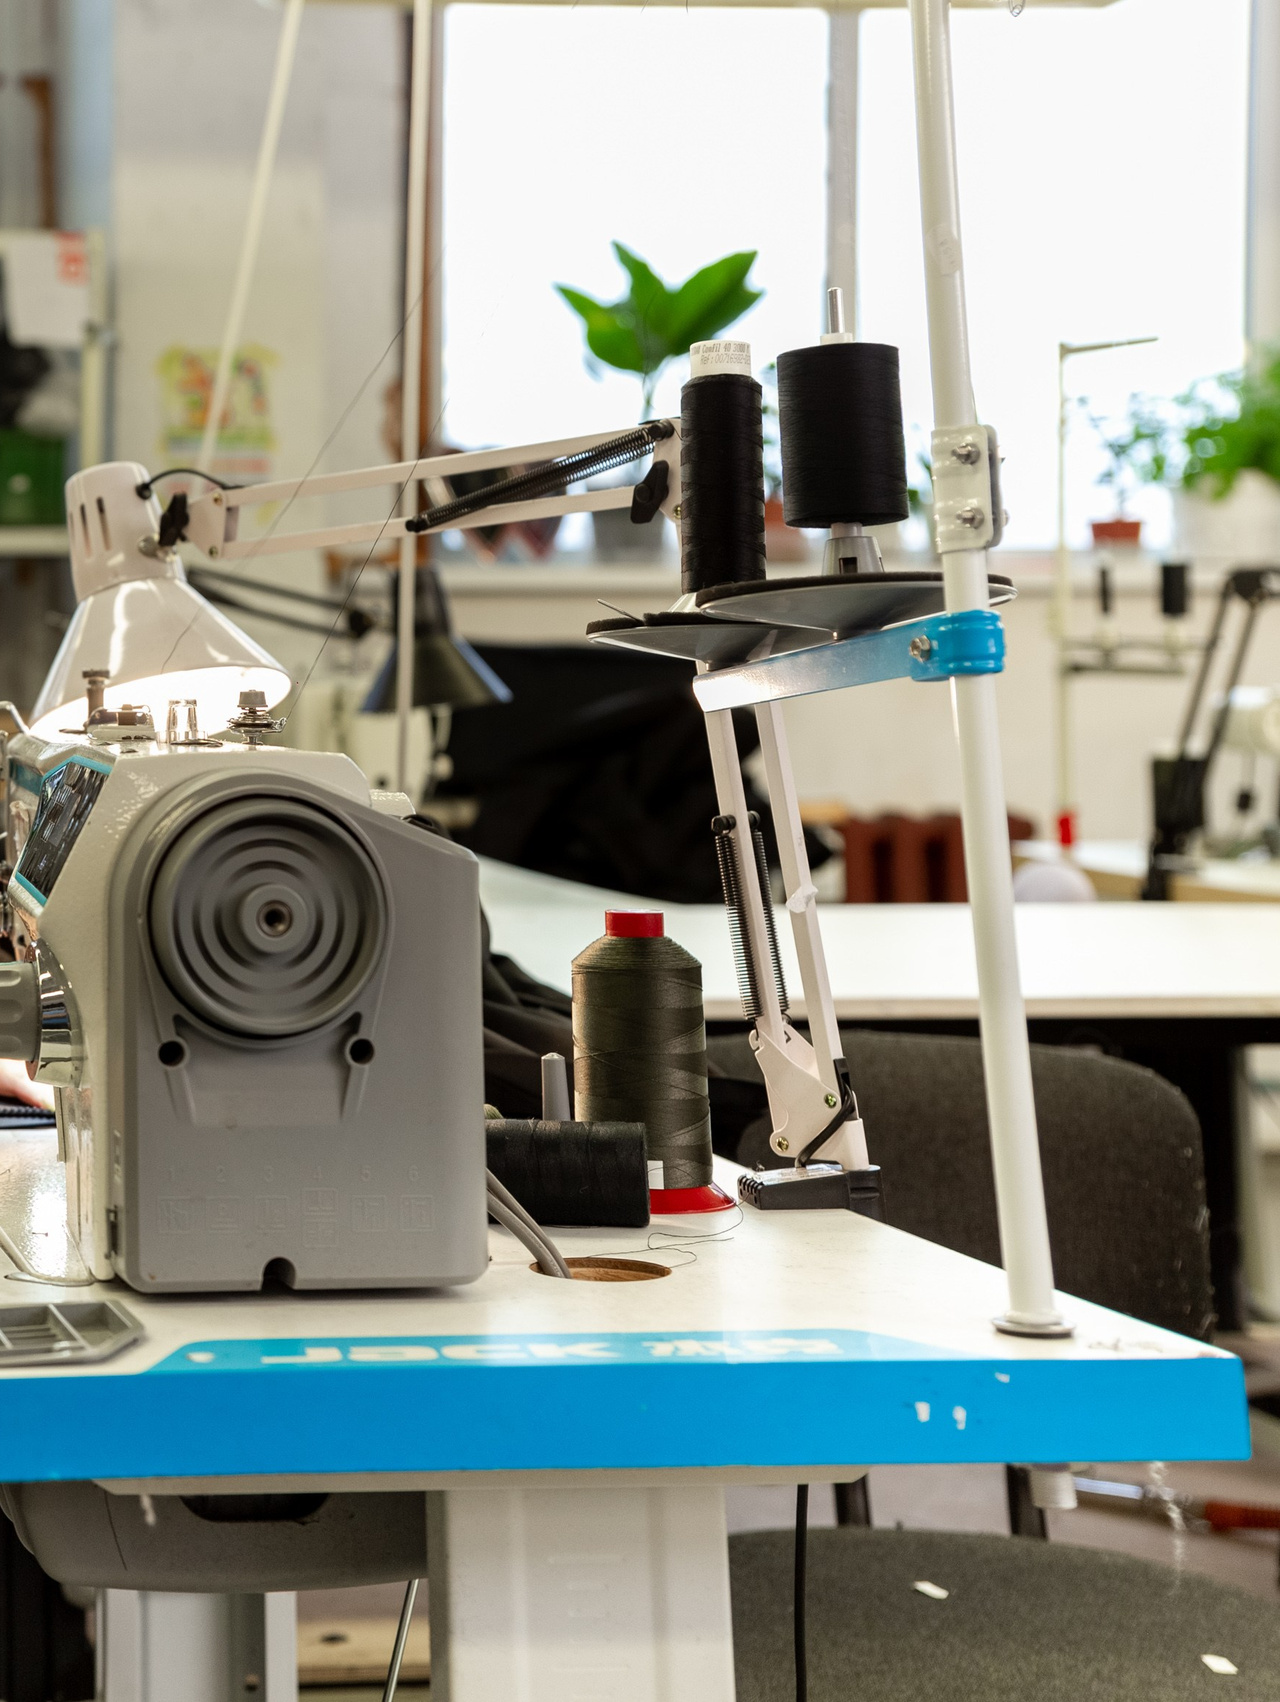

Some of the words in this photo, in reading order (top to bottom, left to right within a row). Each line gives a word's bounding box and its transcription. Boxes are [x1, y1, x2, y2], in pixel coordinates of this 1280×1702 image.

[723, 343, 732, 353] 40
[169, 1165, 176, 1182] 1
[216, 1165, 226, 1183] 2
[264, 1165, 274, 1182] 3
[312, 1165, 322, 1181] 4
[361, 1164, 372, 1182] 5
[408, 1164, 419, 1181] 6
[261, 1342, 619, 1364] JACK
